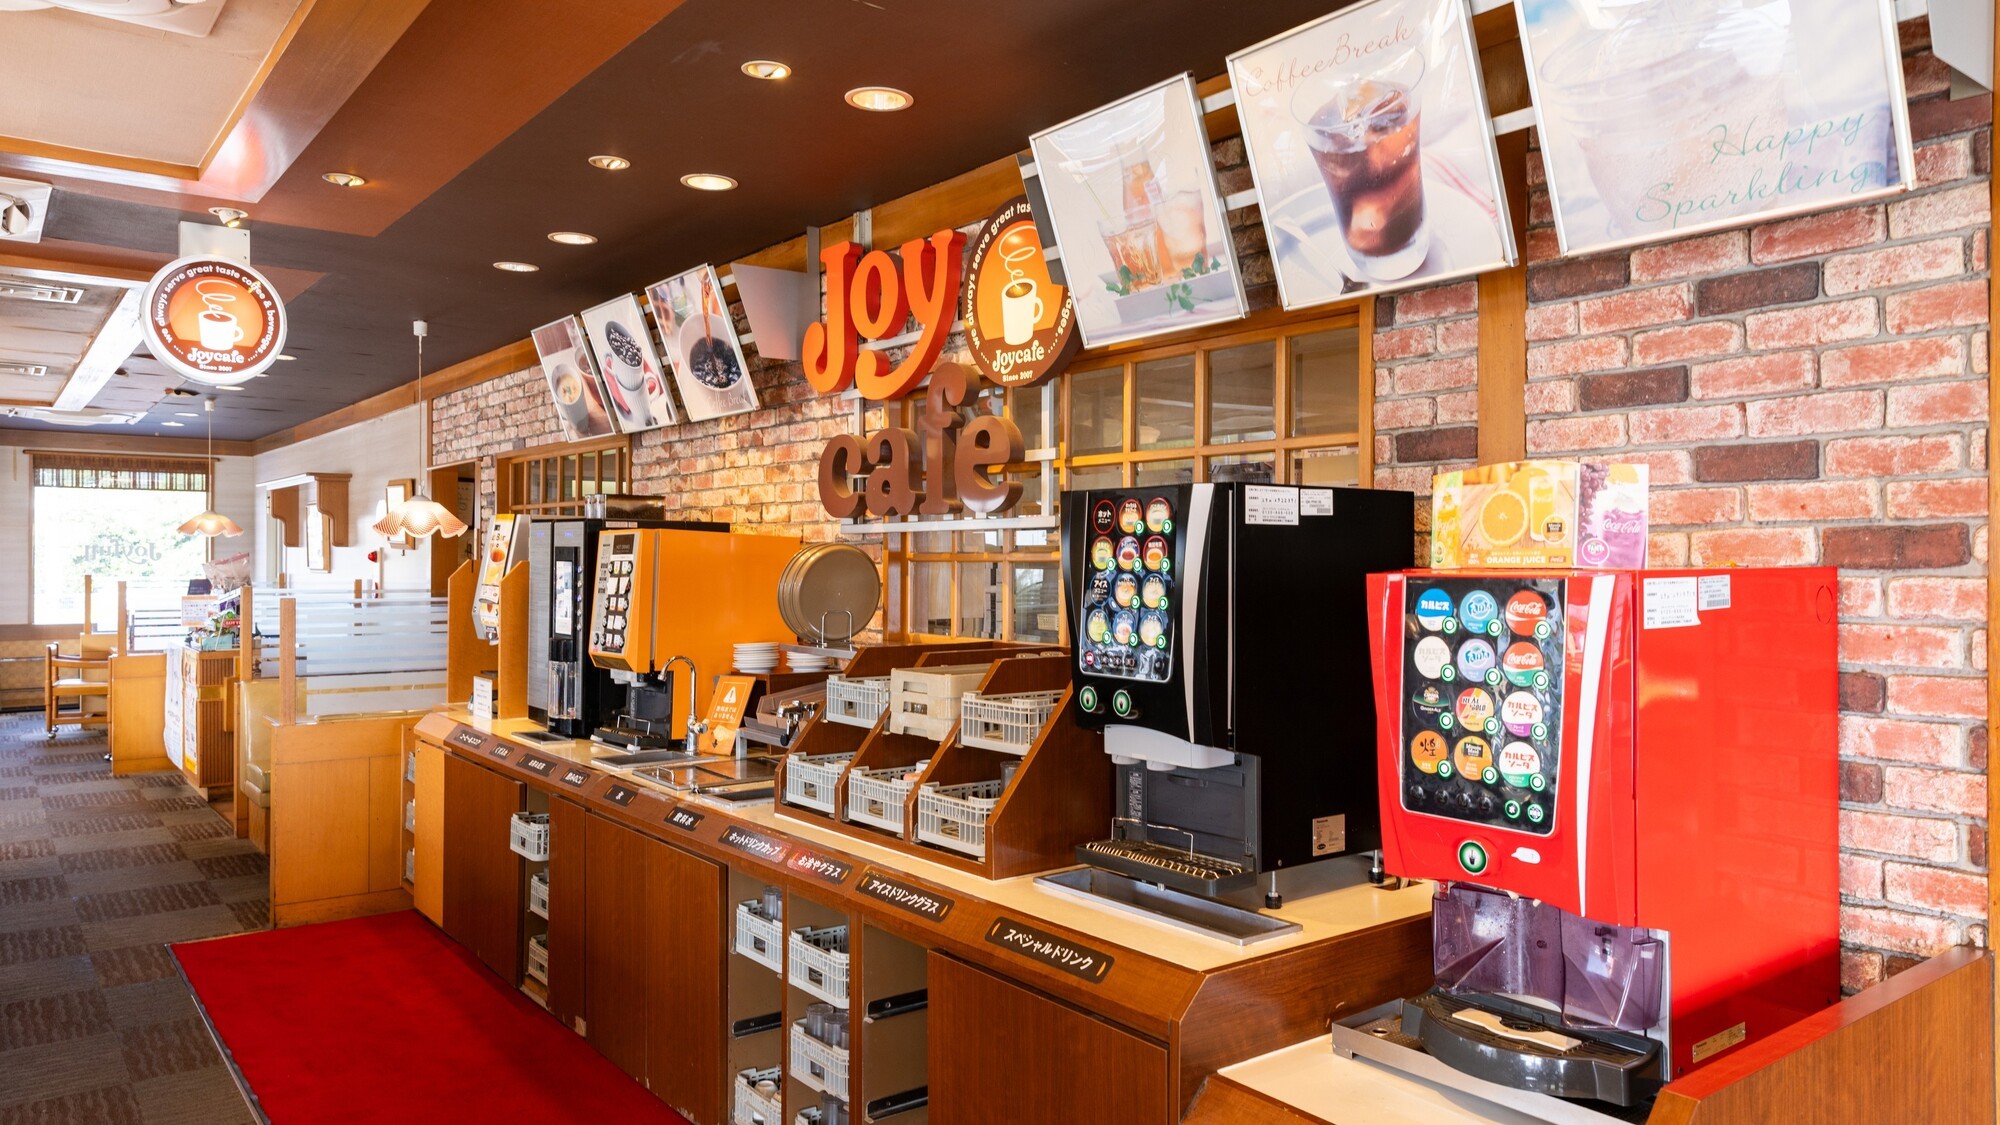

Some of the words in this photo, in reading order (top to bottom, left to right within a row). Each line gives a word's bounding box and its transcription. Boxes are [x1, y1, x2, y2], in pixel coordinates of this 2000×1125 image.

[1707, 112, 1878, 164] Happy
[1635, 161, 1880, 229] Sparkling
[965, 273, 976, 327] always
[972, 234, 990, 270] serve
[990, 205, 1015, 235] great
[155, 292, 168, 327] always
[165, 272, 186, 294] serve
[186, 264, 214, 278] great
[215, 265, 240, 279] taste
[241, 275, 265, 300] coffee
[263, 300, 272, 309] &
[802, 229, 966, 400] Joy
[187, 347, 245, 365] Joycafe
[992, 339, 1045, 375] Joycafe
[1002, 374, 1019, 383] Since
[1019, 369, 1034, 380] 2007
[817, 362, 1026, 519] cafe
[1486, 555, 1521, 564] ORANGE
[1522, 555, 1546, 565] JUICE
[1421, 599, 1450, 611] カルピス
[1467, 600, 1493, 616] Fanta
[1509, 600, 1543, 616] Coca-Cola
[1465, 650, 1491, 664] Fanta
[1506, 652, 1539, 666] Coca-Cola
[1462, 697, 1479, 705] REAL
[1507, 701, 1539, 712] カルピス
[1511, 710, 1533, 719] ソーダ
[1504, 751, 1535, 762] カルピス
[1508, 760, 1531, 770] ソーダ
[672, 811, 695, 826] 飲料水
[728, 831, 782, 855] ホットドリンクカップ
[797, 855, 842, 878] お冷やグラス
[868, 879, 940, 914] アイスドリンクグラス
[1003, 928, 1094, 971] スペシャルドリンク
